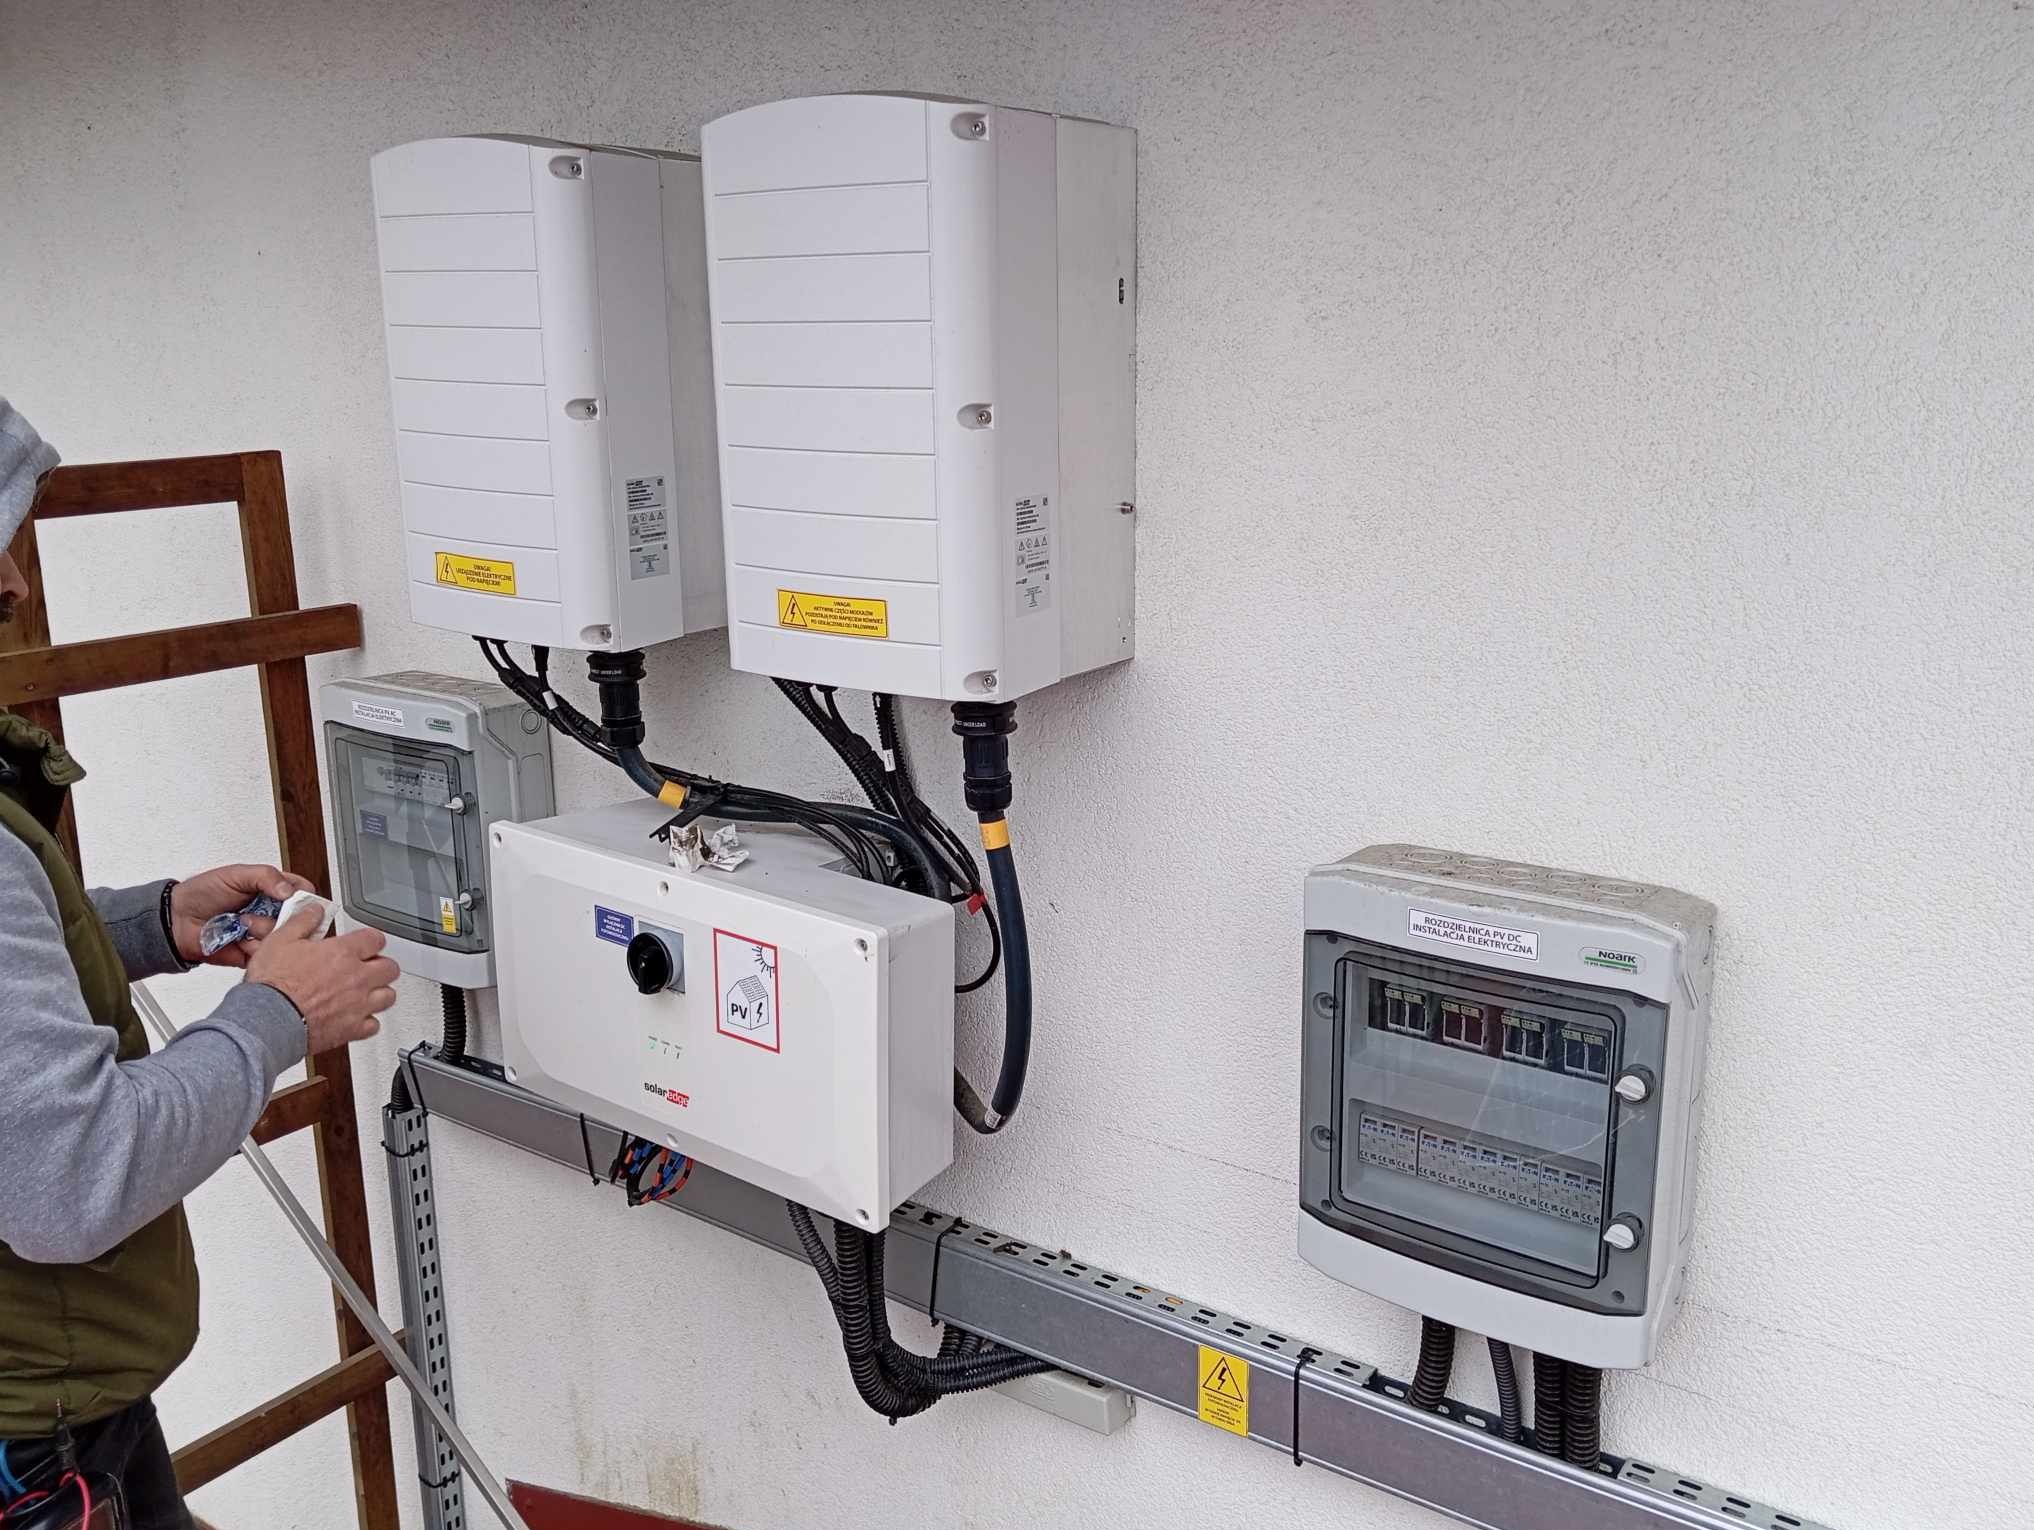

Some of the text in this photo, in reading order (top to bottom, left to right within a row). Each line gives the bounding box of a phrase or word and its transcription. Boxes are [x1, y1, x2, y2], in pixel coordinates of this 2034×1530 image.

[1412, 923, 1533, 955] INSTALACJA ELEKTRYCZNA
[1424, 916, 1522, 943] ROZDZIELNICA PV DC
[731, 1003, 748, 1019] PV
[644, 1082, 690, 1107] solaredge
